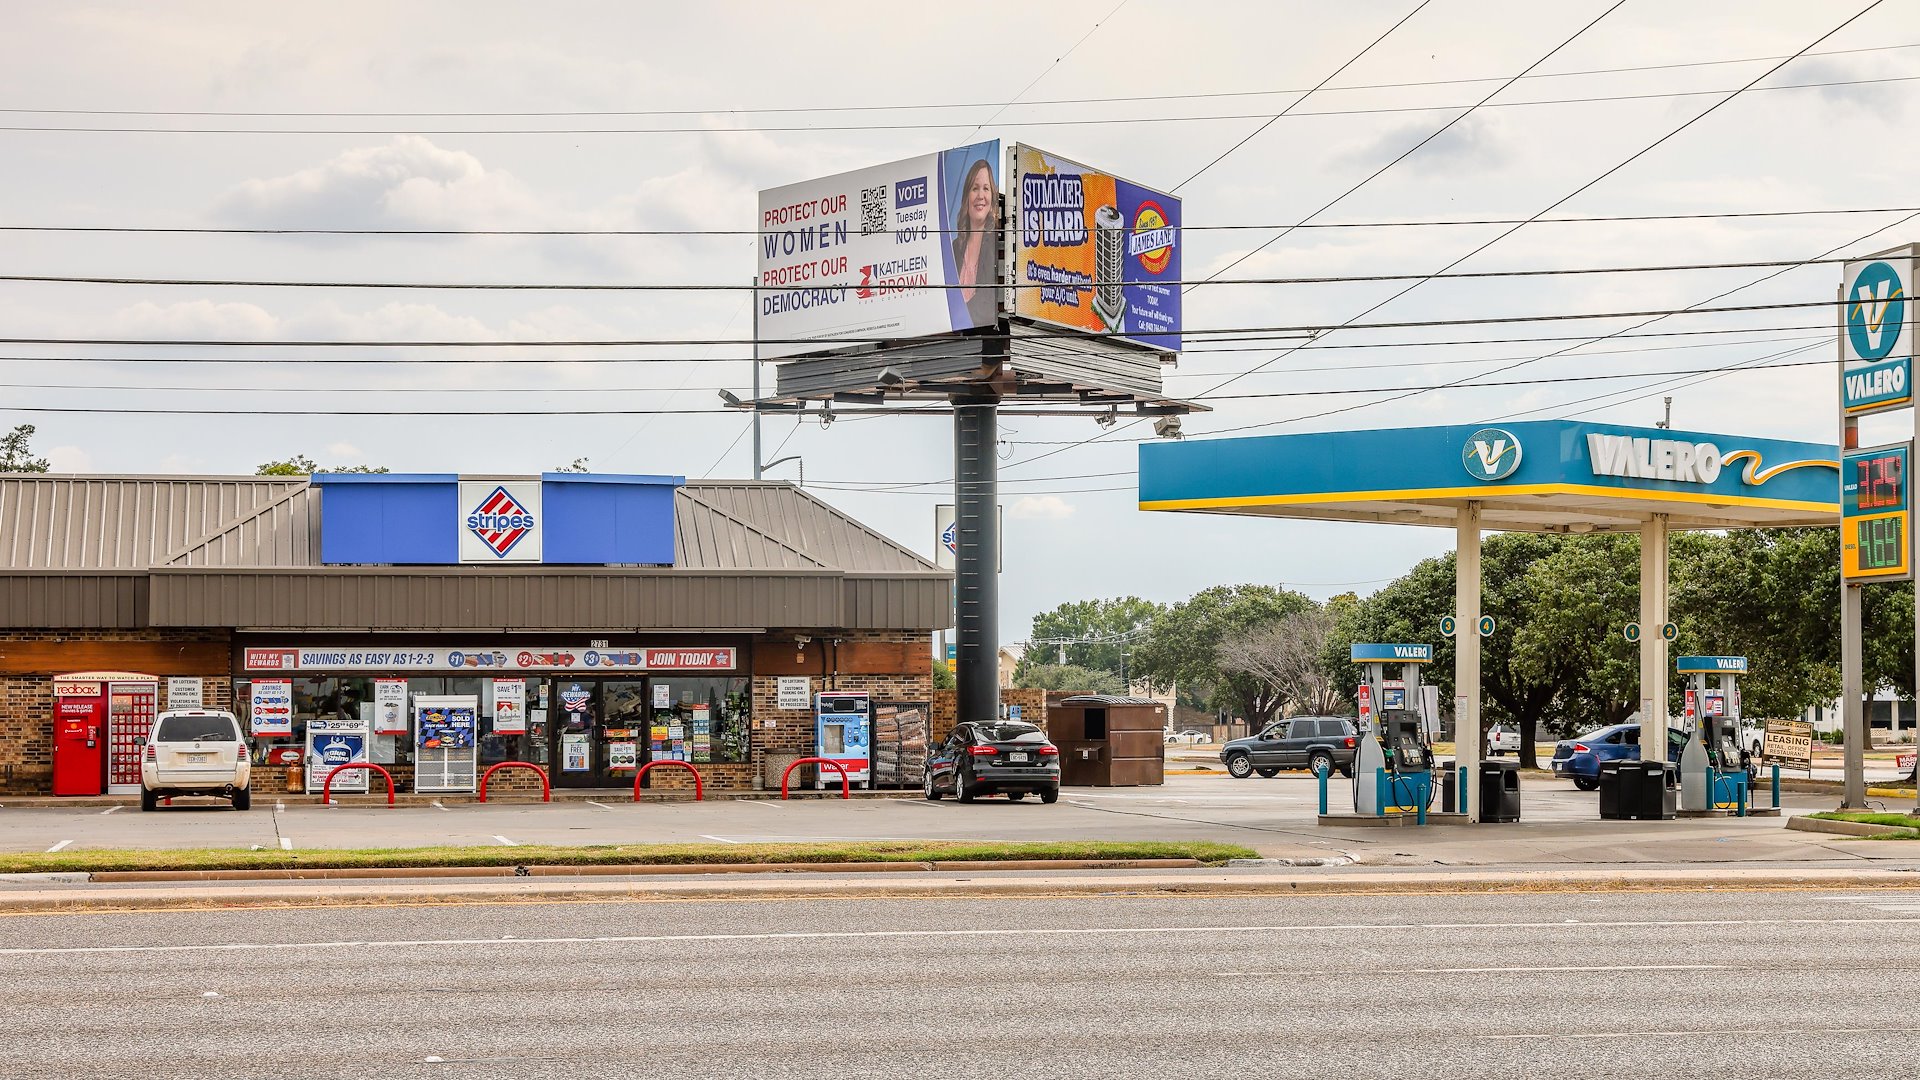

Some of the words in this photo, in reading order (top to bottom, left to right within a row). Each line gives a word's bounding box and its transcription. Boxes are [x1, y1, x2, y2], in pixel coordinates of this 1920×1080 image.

[898, 184, 925, 202] VOTE
[1023, 178, 1083, 209] SUMMER
[764, 201, 818, 228] PROTECT
[821, 195, 847, 215] OUR
[896, 209, 928, 224] Tuesday
[896, 226, 918, 244] NOV
[921, 225, 927, 240] 8
[1024, 210, 1040, 242] IS
[1043, 210, 1088, 242] HARD.
[764, 219, 846, 259] WOMEN
[1133, 232, 1155, 253] JAMES
[1155, 228, 1172, 247] LANE
[763, 262, 818, 287] PROTECT
[821, 256, 847, 277] OUR
[880, 255, 928, 277] KATHLEEN
[1038, 268, 1050, 281] even
[1051, 267, 1071, 284] harder
[880, 273, 928, 295] BROWN
[763, 282, 848, 316] DEMOCRACY
[1041, 287, 1055, 300] your
[1055, 287, 1066, 304] A/C
[1858, 279, 1890, 350] V
[1845, 365, 1905, 401] VALERO
[1474, 440, 1506, 474] V
[1587, 434, 1721, 484] VALERO
[467, 512, 534, 532] stripes
[1445, 621, 1452, 631] 3
[1483, 621, 1490, 631] 4
[302, 653, 346, 665] SAVINGS
[348, 653, 363, 665] AS
[364, 653, 391, 665] EASY
[392, 653, 407, 665] AS
[408, 653, 435, 665] 1-2-3
[650, 653, 676, 665] JOIN
[679, 653, 714, 665] TODAY
[1394, 646, 1427, 658] VALERO
[1767, 734, 1809, 746] LEASING
[1769, 748, 1805, 757] RESTAURANT
